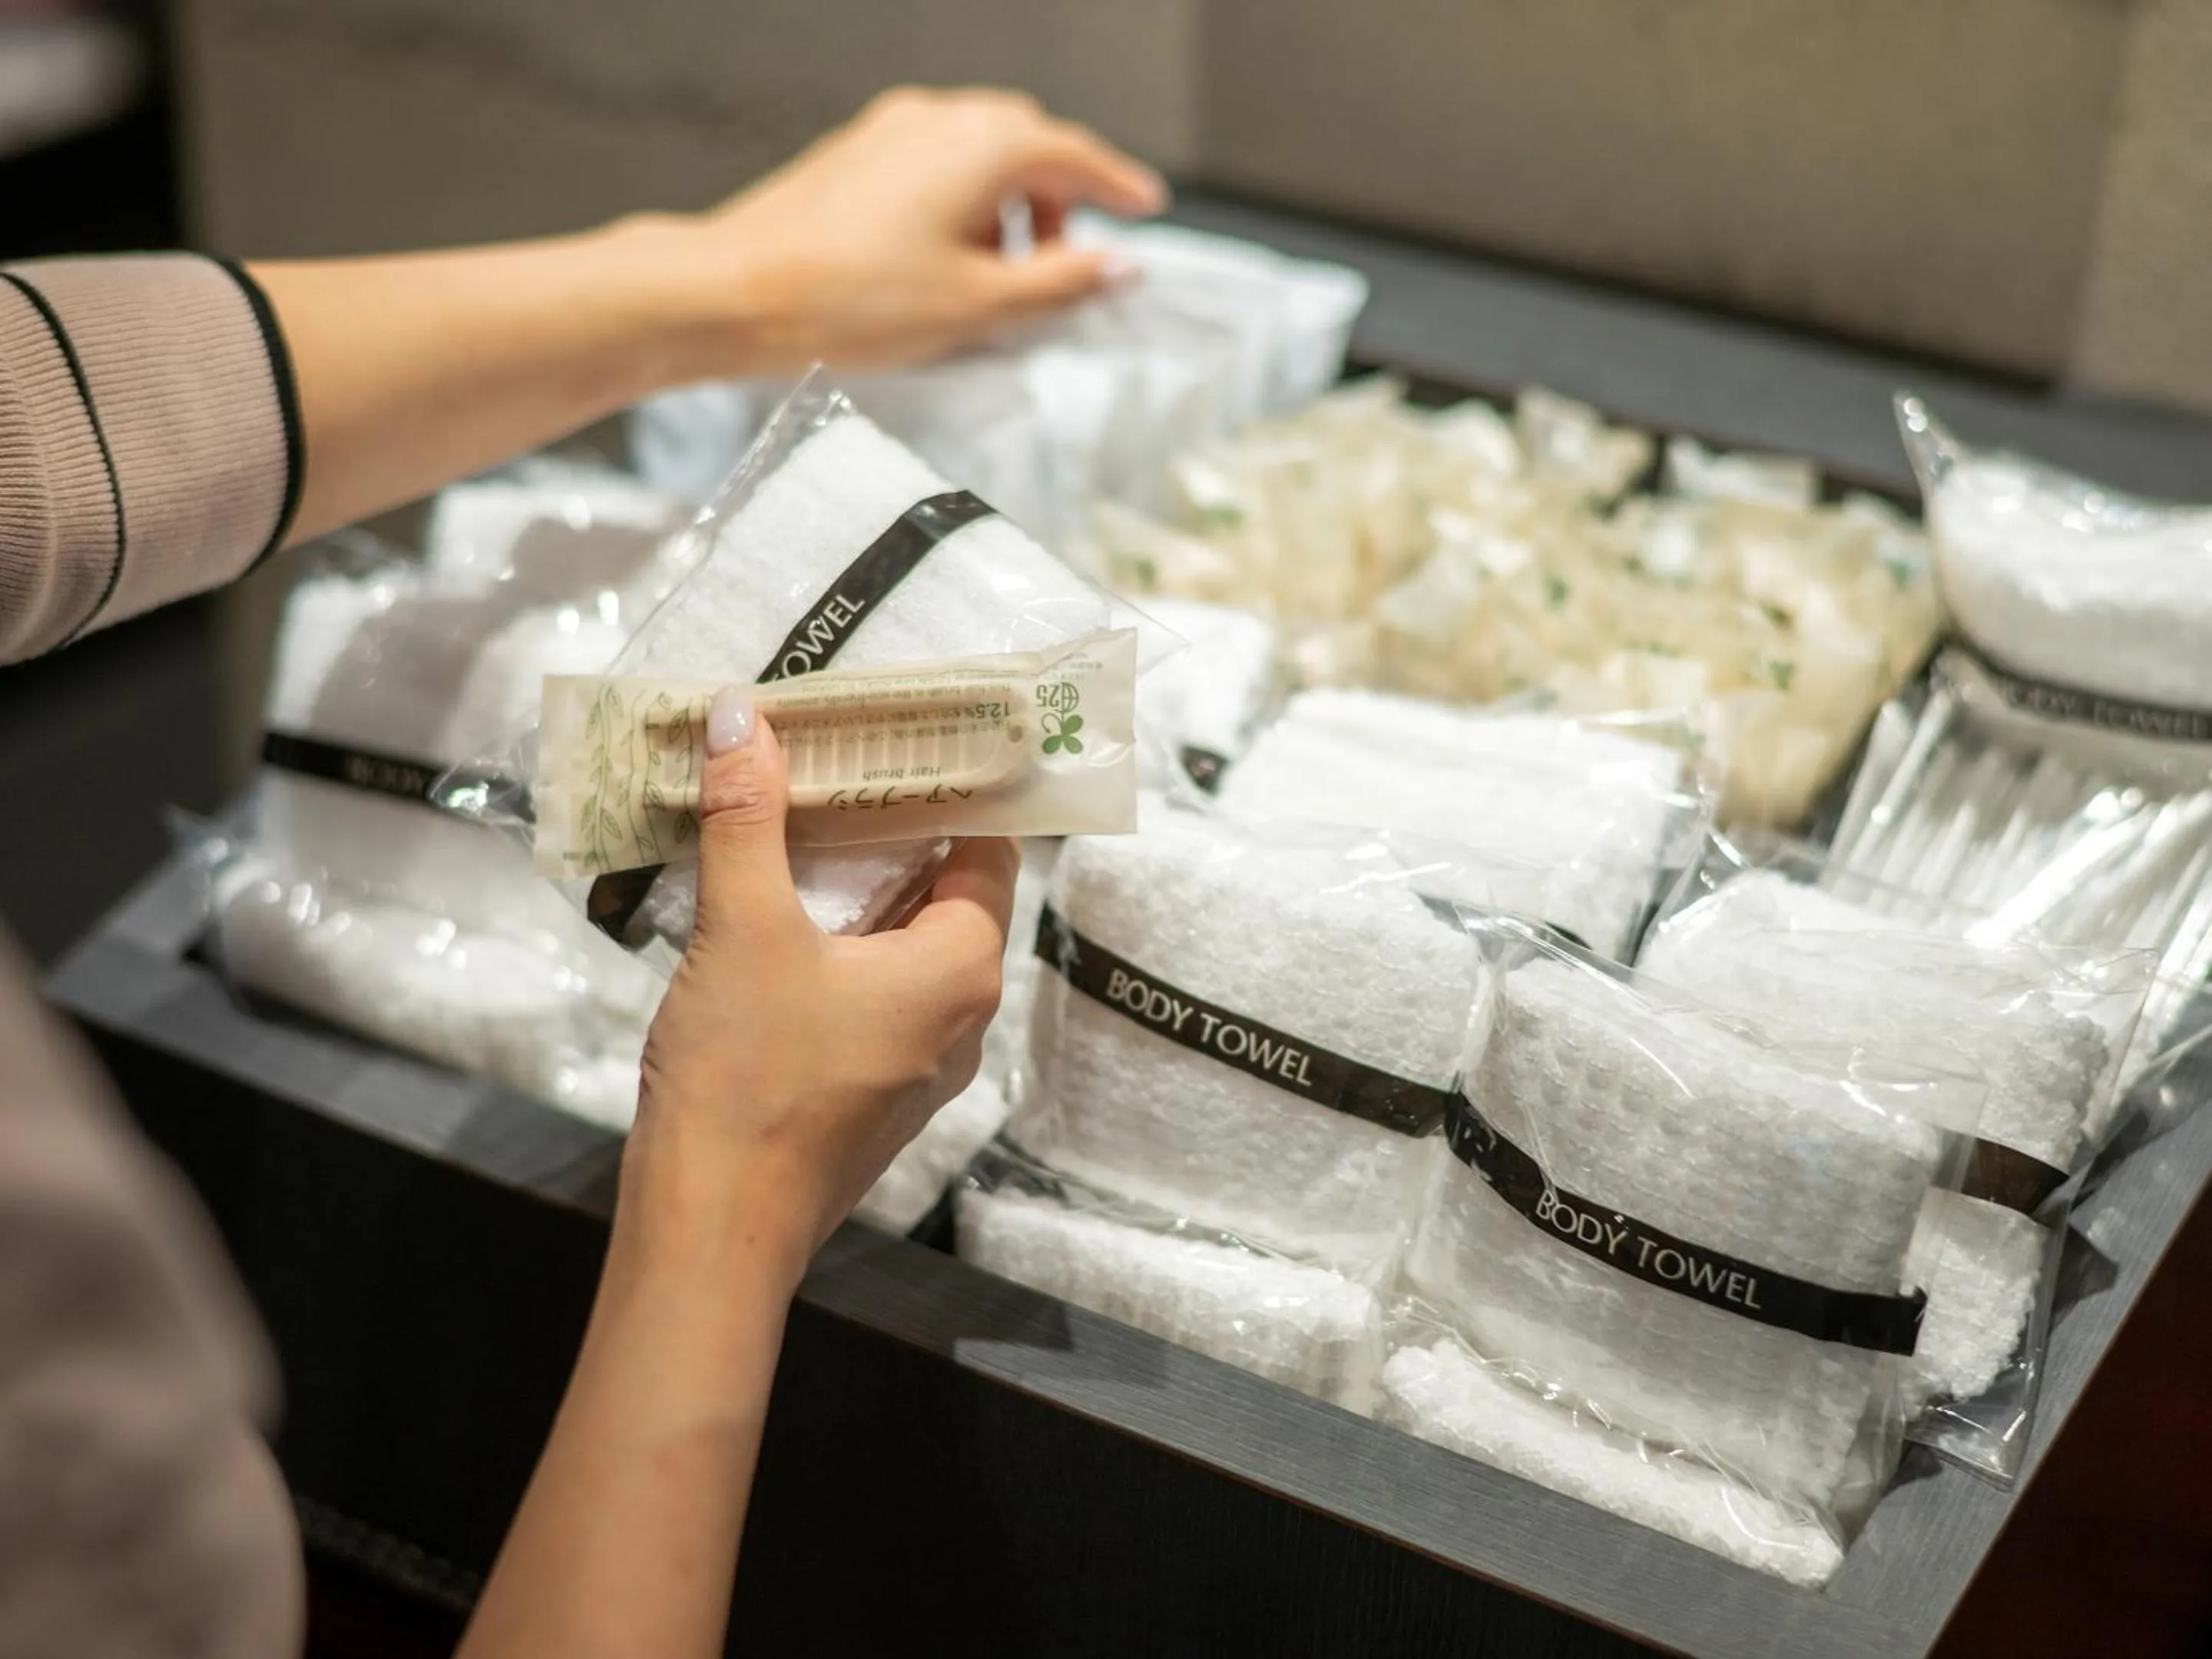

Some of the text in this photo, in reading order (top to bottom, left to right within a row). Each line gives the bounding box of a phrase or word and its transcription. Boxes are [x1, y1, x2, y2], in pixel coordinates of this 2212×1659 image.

[770, 594, 866, 681] OWEL
[1036, 684, 1061, 707] 25
[827, 784, 973, 811] ヘアーブラシ
[863, 766, 941, 782] Hair brush
[1106, 969, 1312, 1087] BODY TOWEL
[1536, 1190, 1762, 1310] BODY TOWEL
